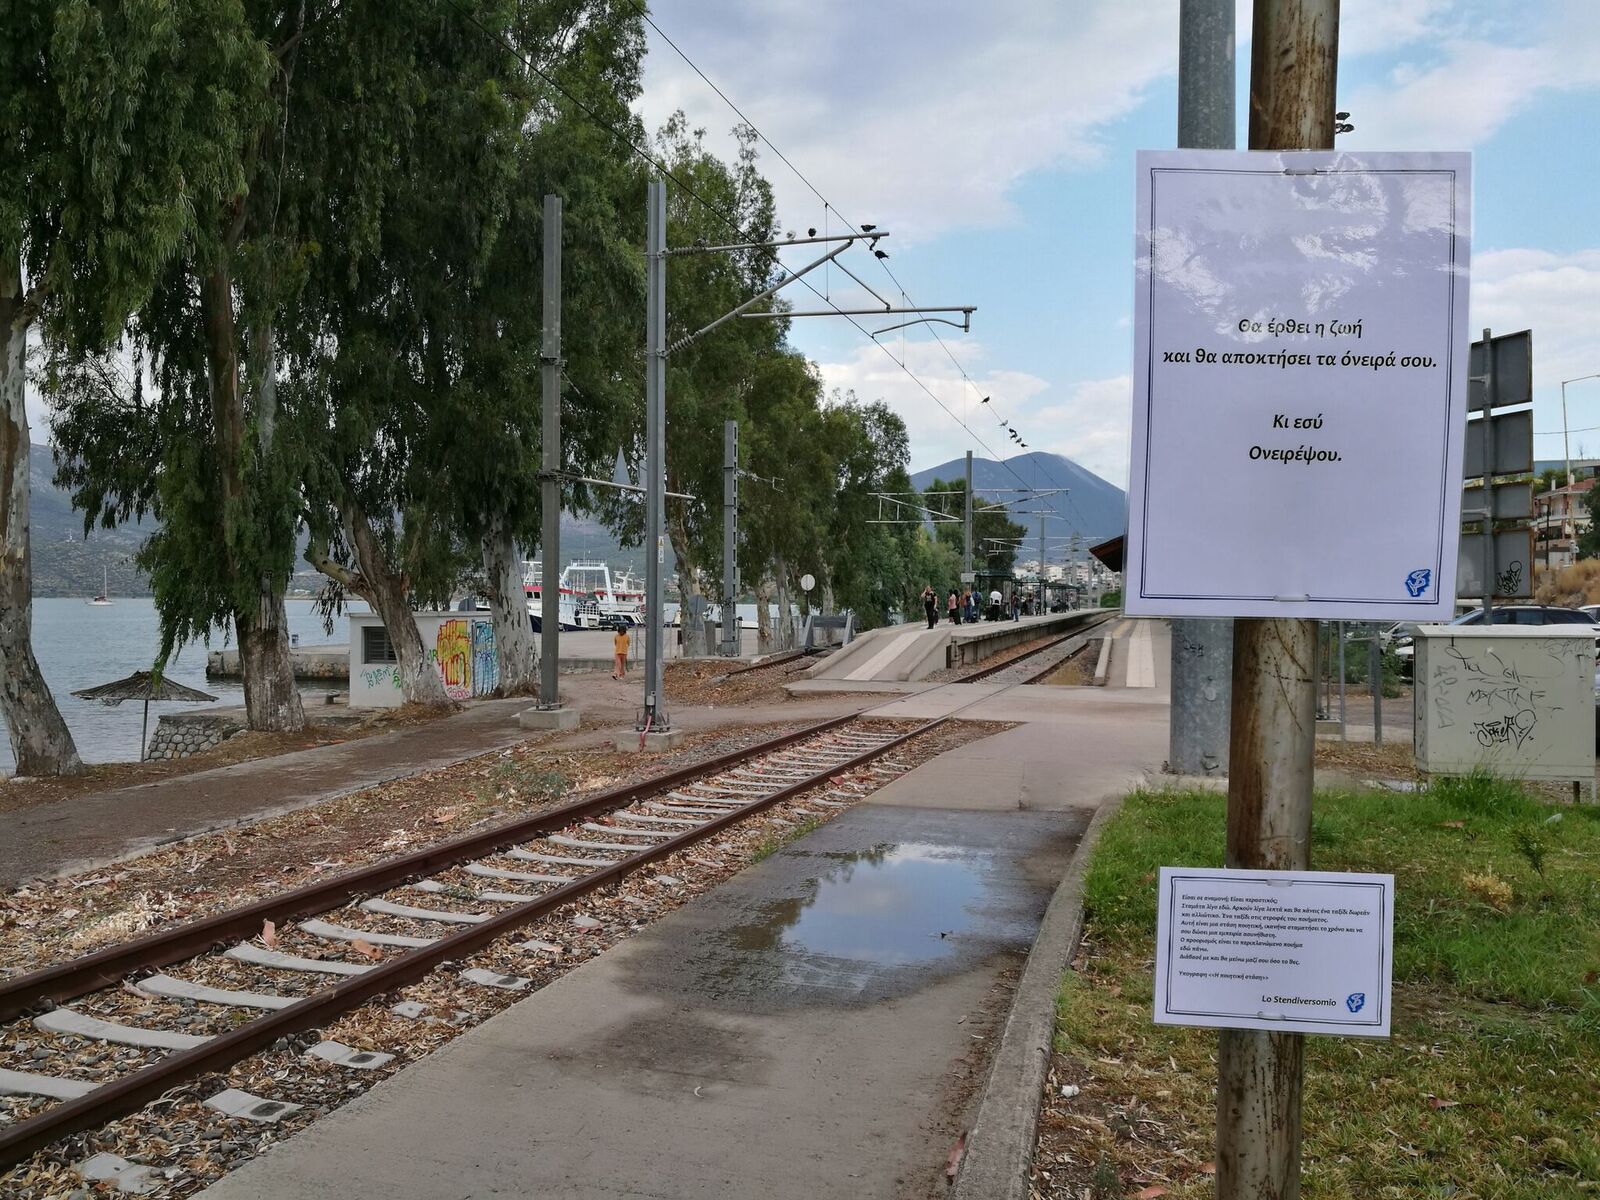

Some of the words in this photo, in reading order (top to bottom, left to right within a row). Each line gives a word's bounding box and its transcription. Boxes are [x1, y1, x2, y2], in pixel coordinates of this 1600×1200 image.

[1238, 319, 1262, 333] Θα
[1268, 318, 1310, 337] έρθει
[1315, 323, 1324, 337] η
[1330, 319, 1363, 338] ζωή
[1163, 350, 1191, 363] και
[1195, 348, 1217, 363] θα
[1222, 349, 1311, 369] αποκτήσει
[1316, 354, 1337, 366] τα
[1341, 351, 1396, 370] όνειρά
[1401, 355, 1437, 367] σου.
[1273, 414, 1289, 429] Κι
[1293, 414, 1323, 429] εσύ
[1249, 445, 1342, 465] Ονειρέψου.
[1262, 995, 1272, 1003] Lo
[1273, 996, 1336, 1006] Stendiversomio
